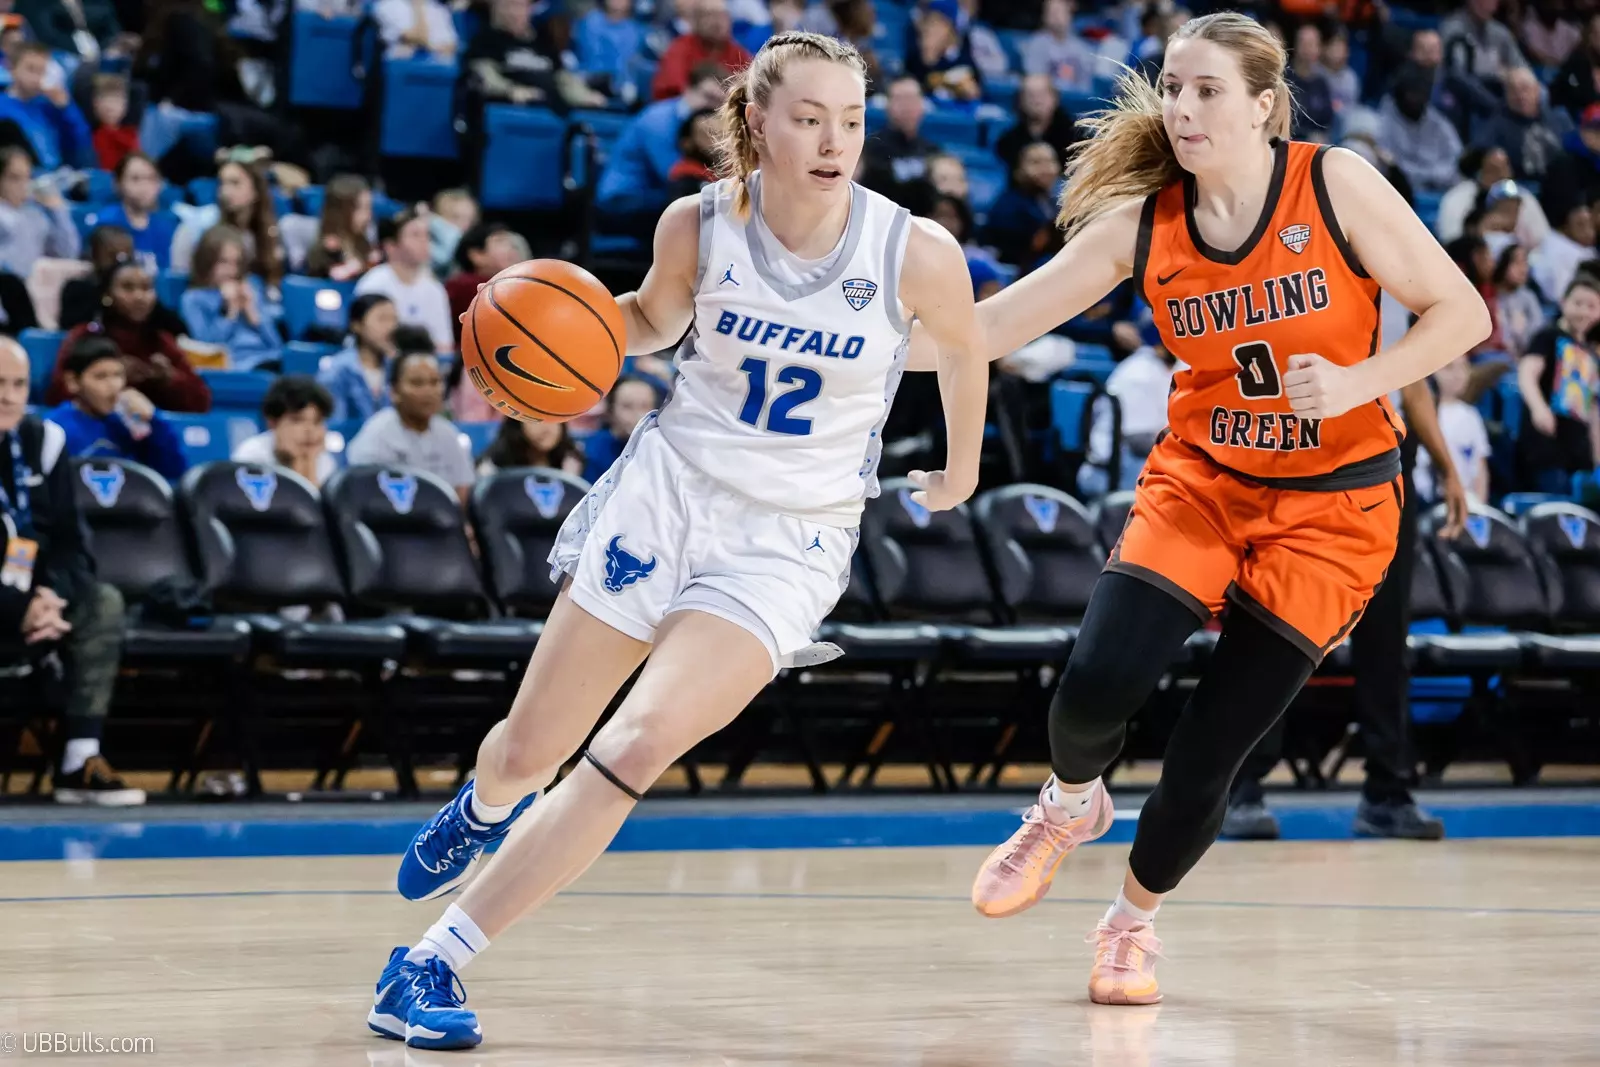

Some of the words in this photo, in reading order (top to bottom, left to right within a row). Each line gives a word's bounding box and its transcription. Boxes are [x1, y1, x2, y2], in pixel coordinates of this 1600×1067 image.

[1281, 231, 1310, 245] MAC
[844, 287, 875, 298] MAC
[1166, 267, 1330, 338] BOWLING
[713, 308, 865, 359] BUFFALO
[736, 355, 825, 436] 12
[1232, 340, 1283, 400] 0
[1209, 405, 1322, 451] GREEN
